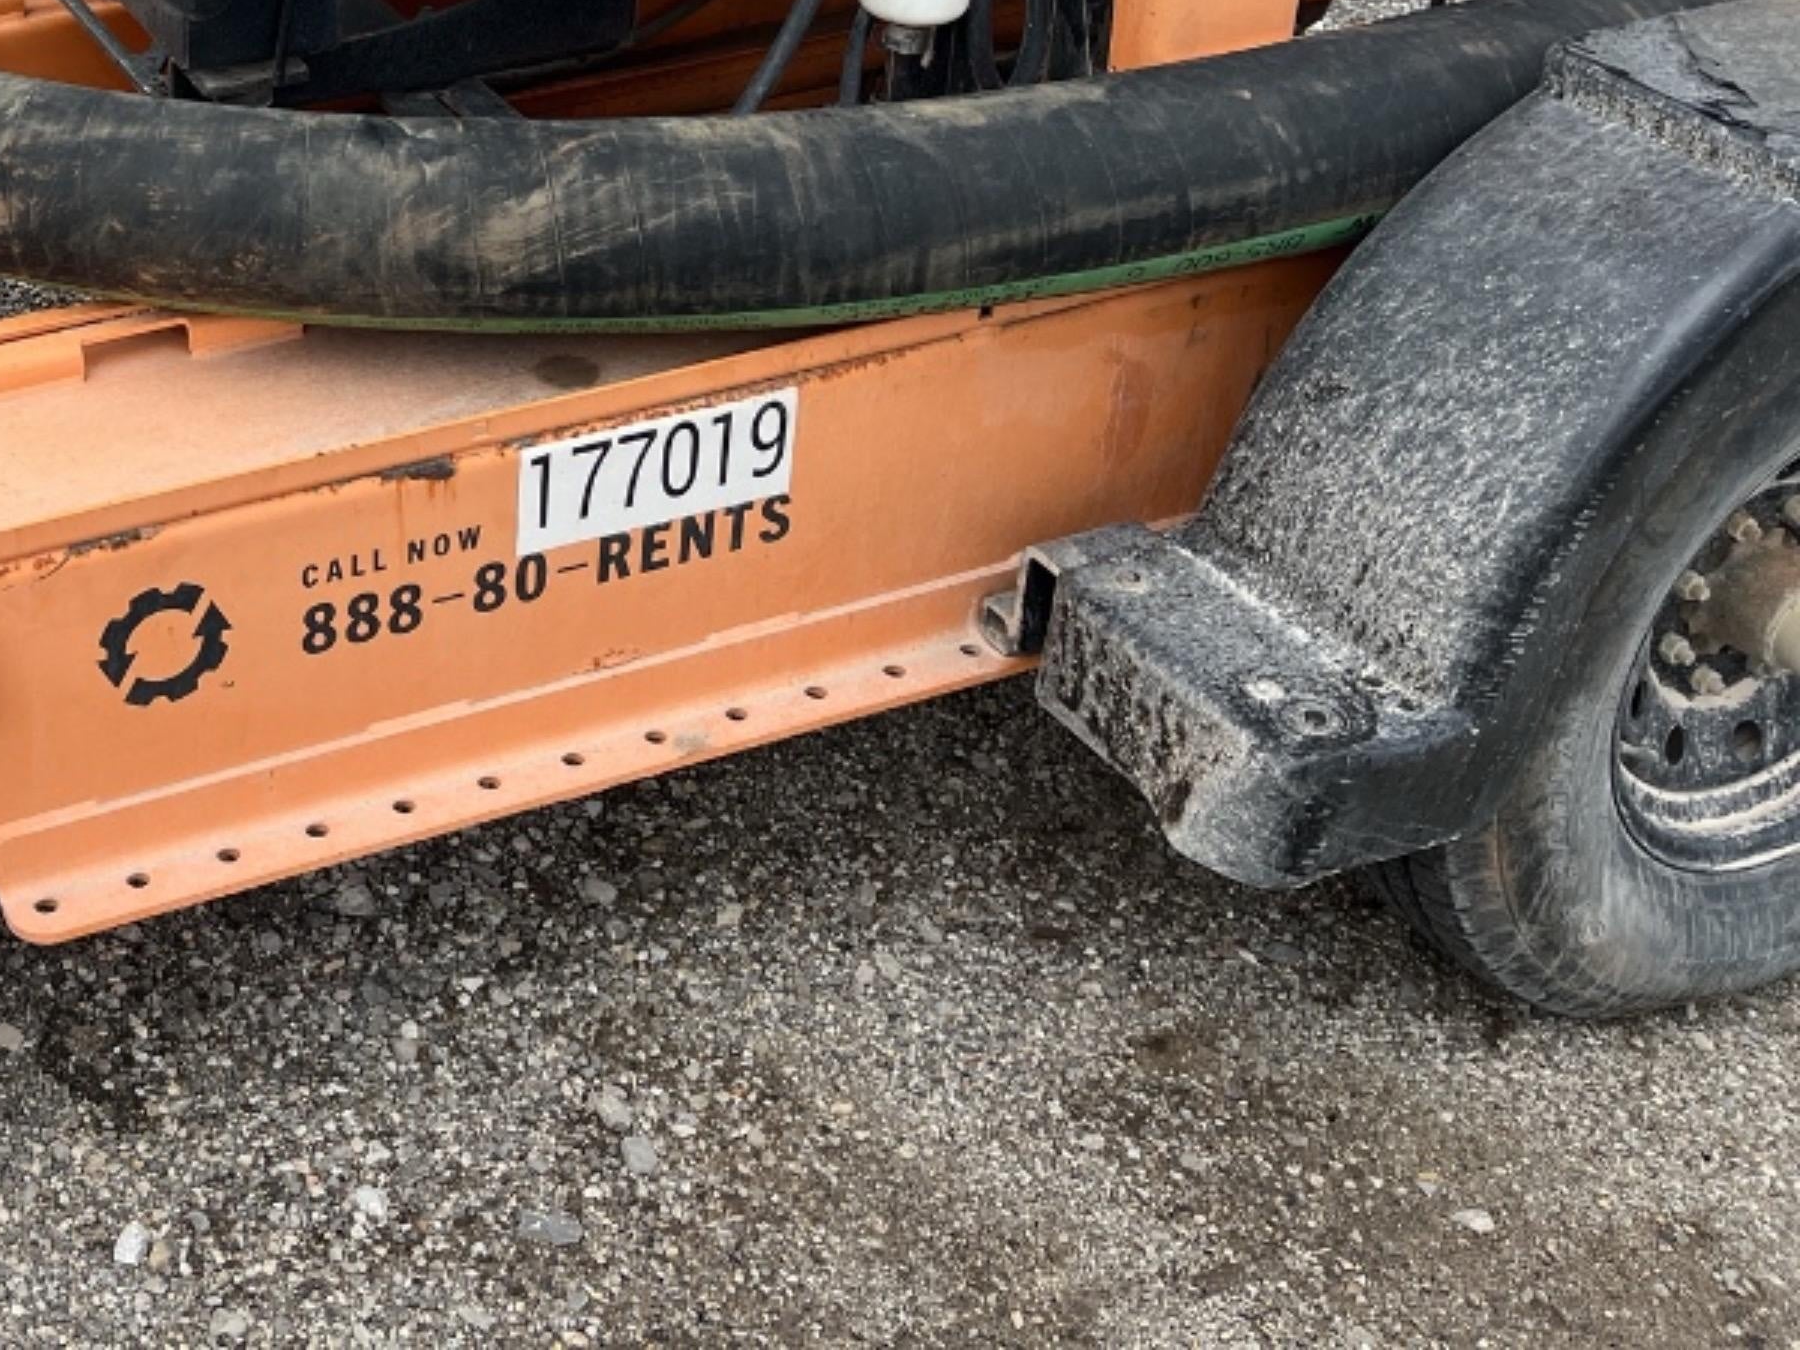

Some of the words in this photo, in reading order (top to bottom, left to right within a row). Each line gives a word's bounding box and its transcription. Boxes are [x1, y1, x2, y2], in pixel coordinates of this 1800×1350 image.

[529, 399, 789, 530] 177019
[301, 549, 388, 589] CALL
[407, 525, 483, 564] NOW
[301, 493, 794, 655] 888-80-RENTS
